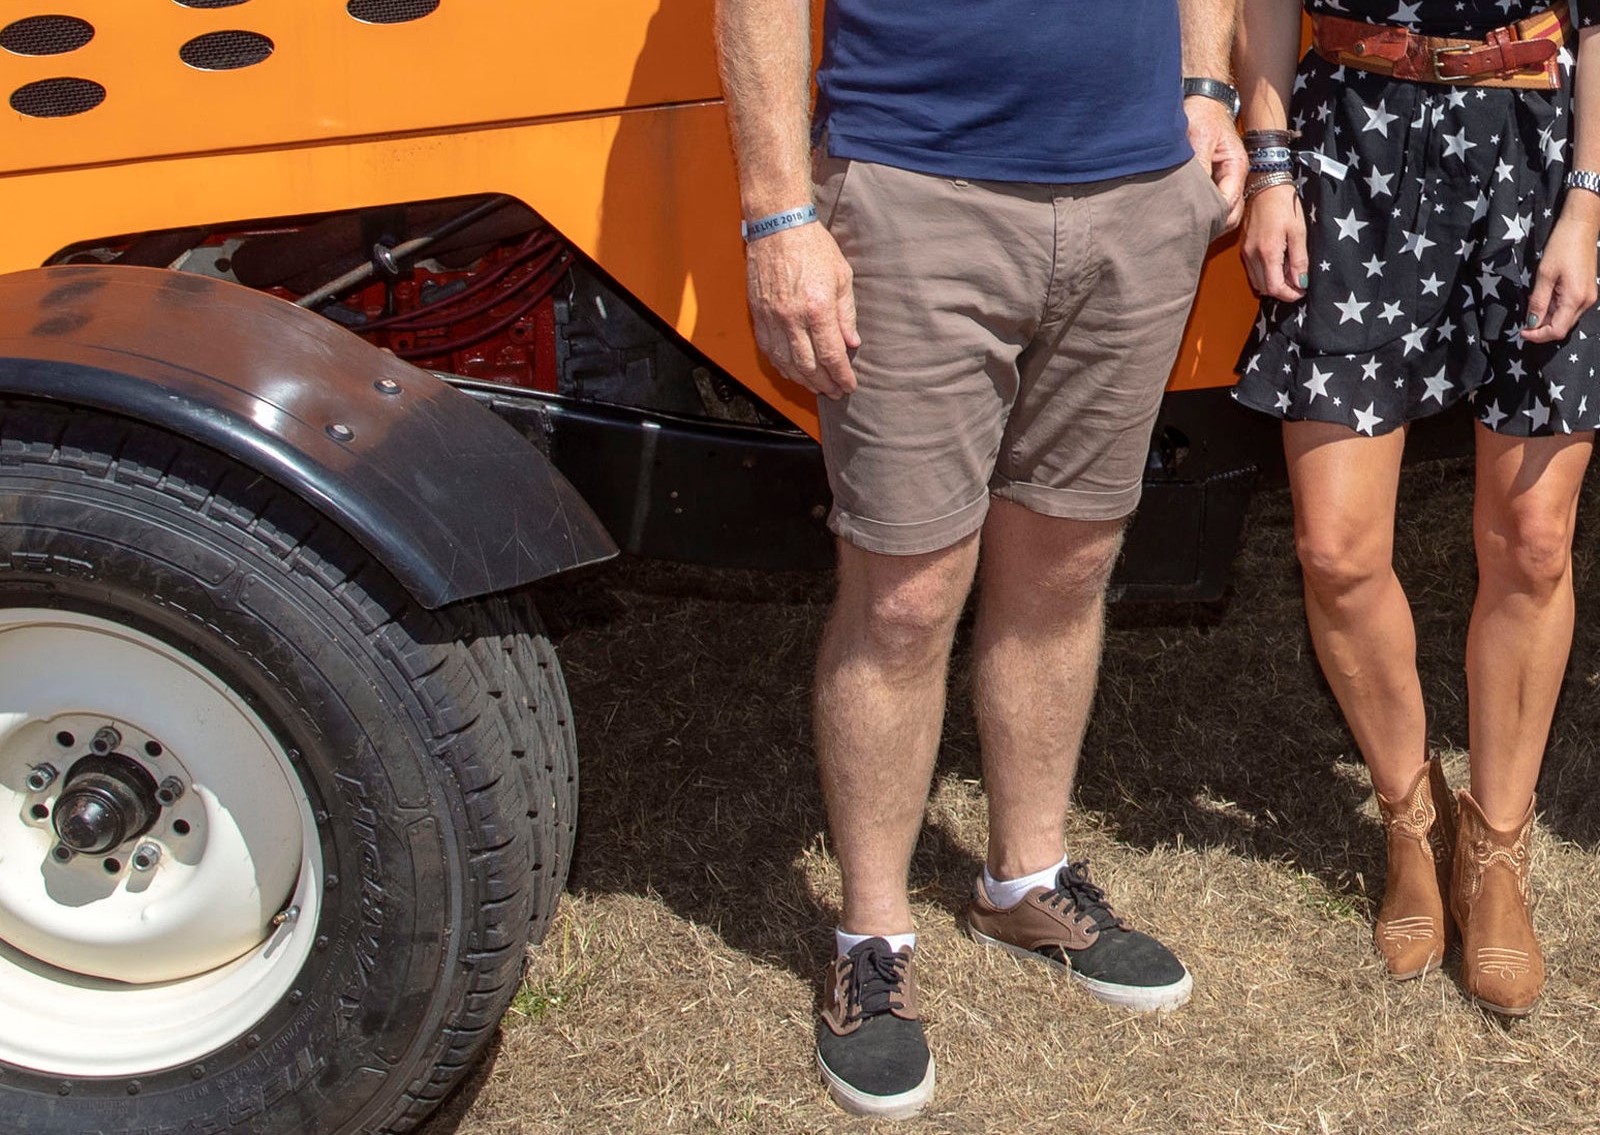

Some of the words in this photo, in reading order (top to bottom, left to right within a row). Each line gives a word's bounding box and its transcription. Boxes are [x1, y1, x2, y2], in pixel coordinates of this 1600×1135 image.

[761, 218, 779, 232] LIVE
[782, 212, 803, 224] 2018
[332, 771, 384, 1040] HIGHWAY
